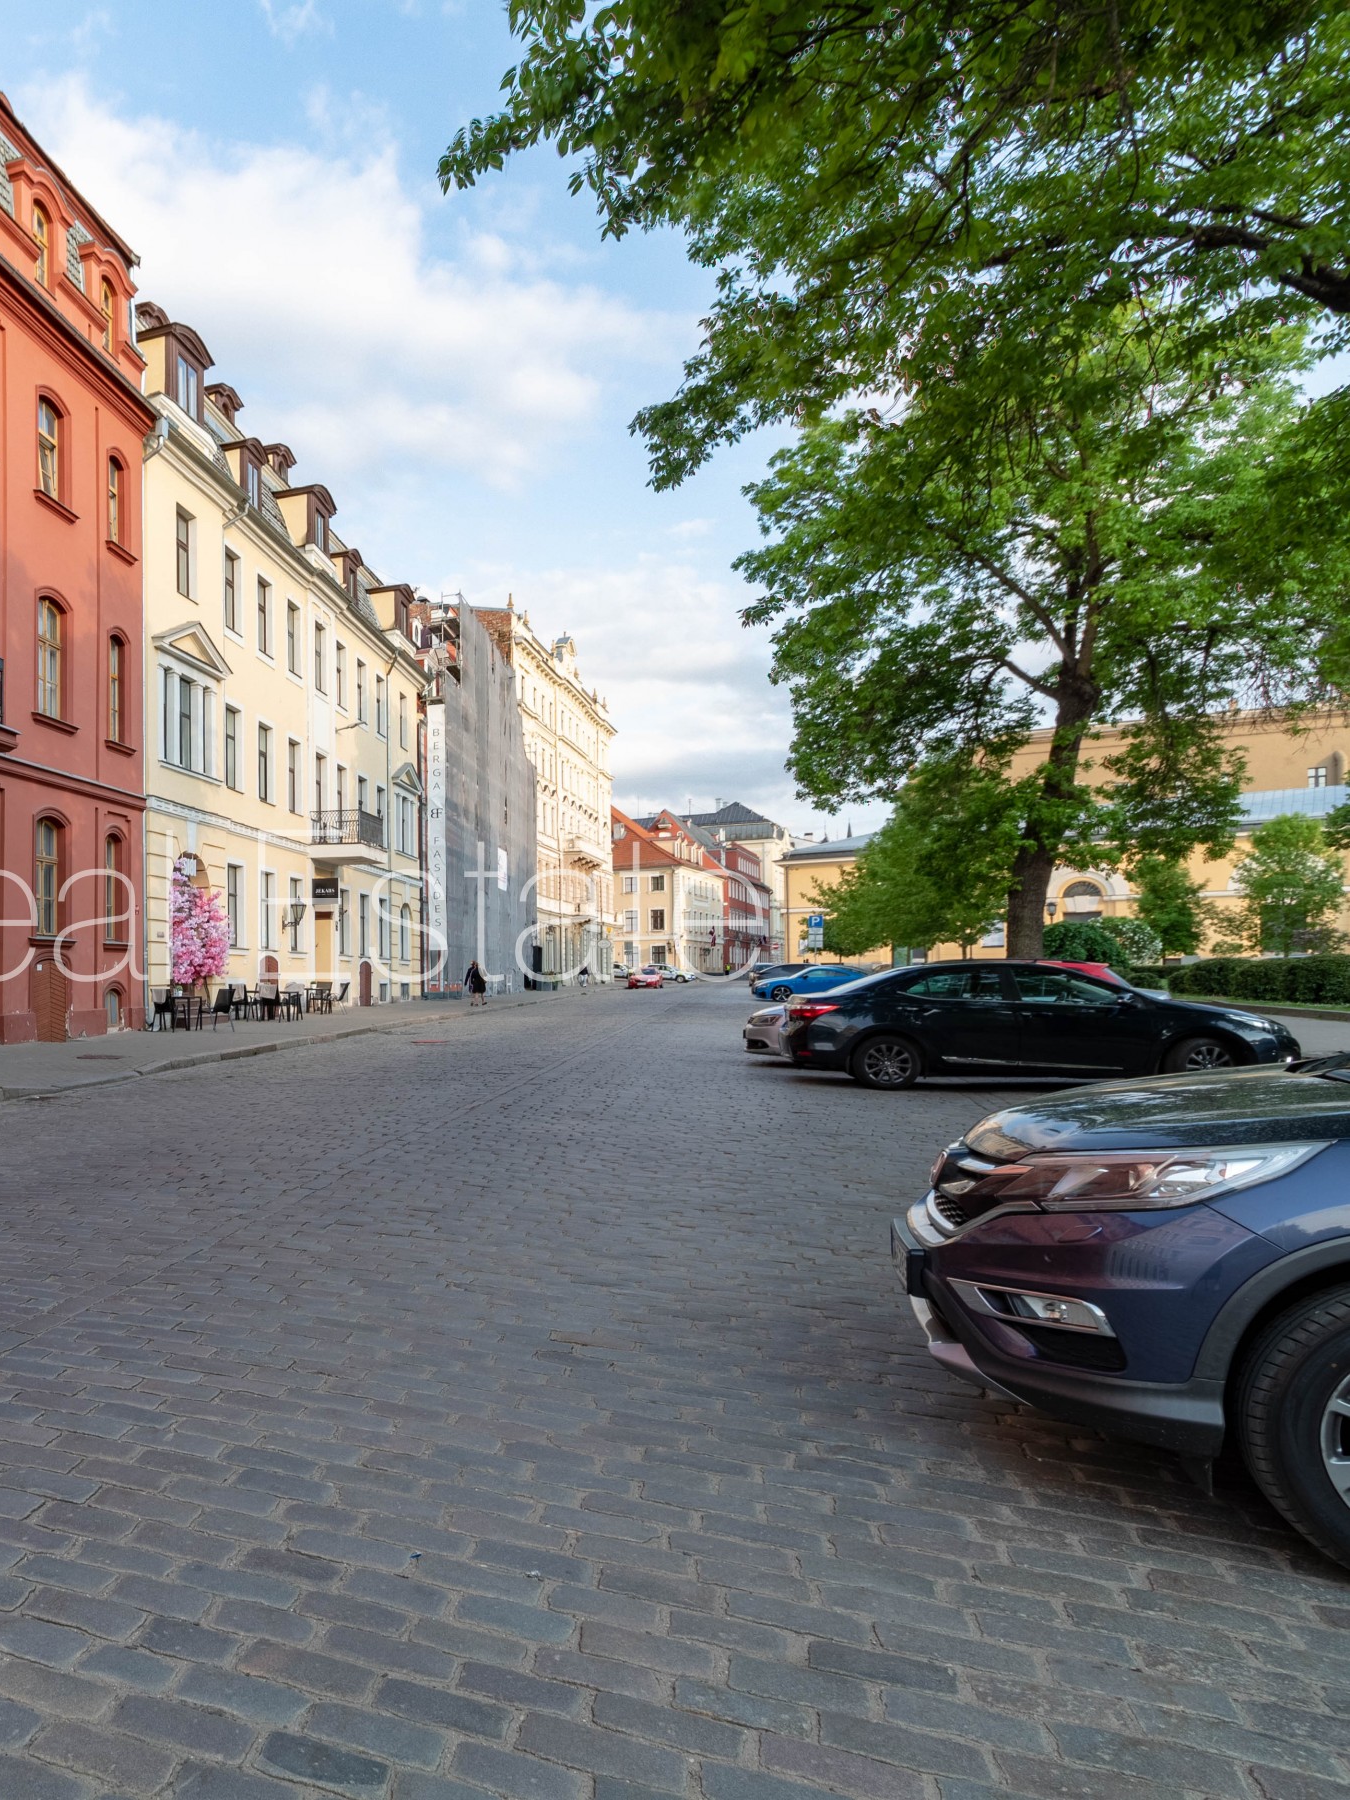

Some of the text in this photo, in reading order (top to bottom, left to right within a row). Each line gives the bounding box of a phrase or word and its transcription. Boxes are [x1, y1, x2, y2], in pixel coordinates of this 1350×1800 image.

[432, 728, 441, 790] BERGA
[433, 836, 442, 927] FASADES
[811, 916, 820, 926] P
